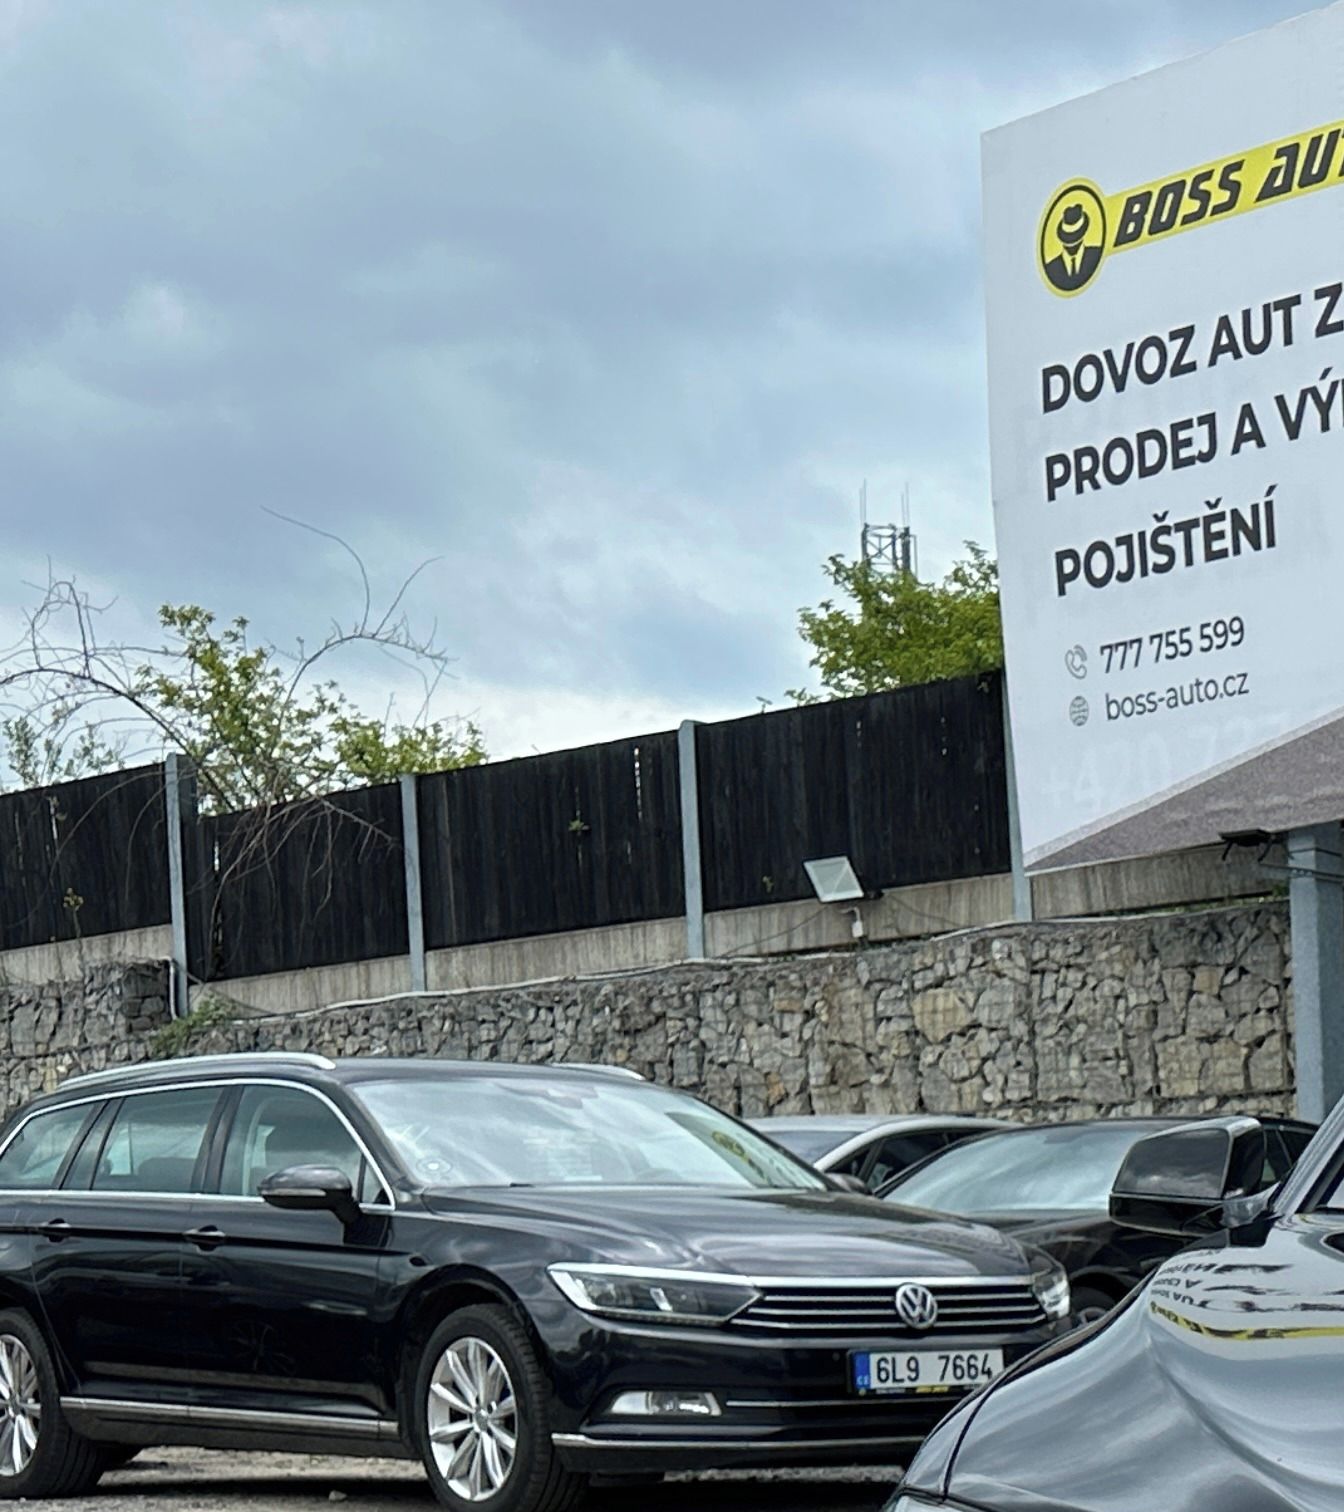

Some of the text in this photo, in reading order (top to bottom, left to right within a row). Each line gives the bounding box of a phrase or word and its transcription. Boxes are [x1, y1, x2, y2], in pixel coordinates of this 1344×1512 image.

[1113, 159, 1246, 248] BOSS
[1041, 324, 1198, 415] DOVOZ
[1207, 293, 1303, 368] AUT
[1313, 284, 1344, 339] Z
[1045, 411, 1217, 502] PRODEJ
[1230, 402, 1267, 456] A
[1055, 483, 1279, 597] POJIŠTĚNÍ
[1099, 615, 1245, 674] 777 755 599
[1105, 672, 1250, 721] boss-auto.cz
[876, 1352, 993, 1384] 6L9 7664
